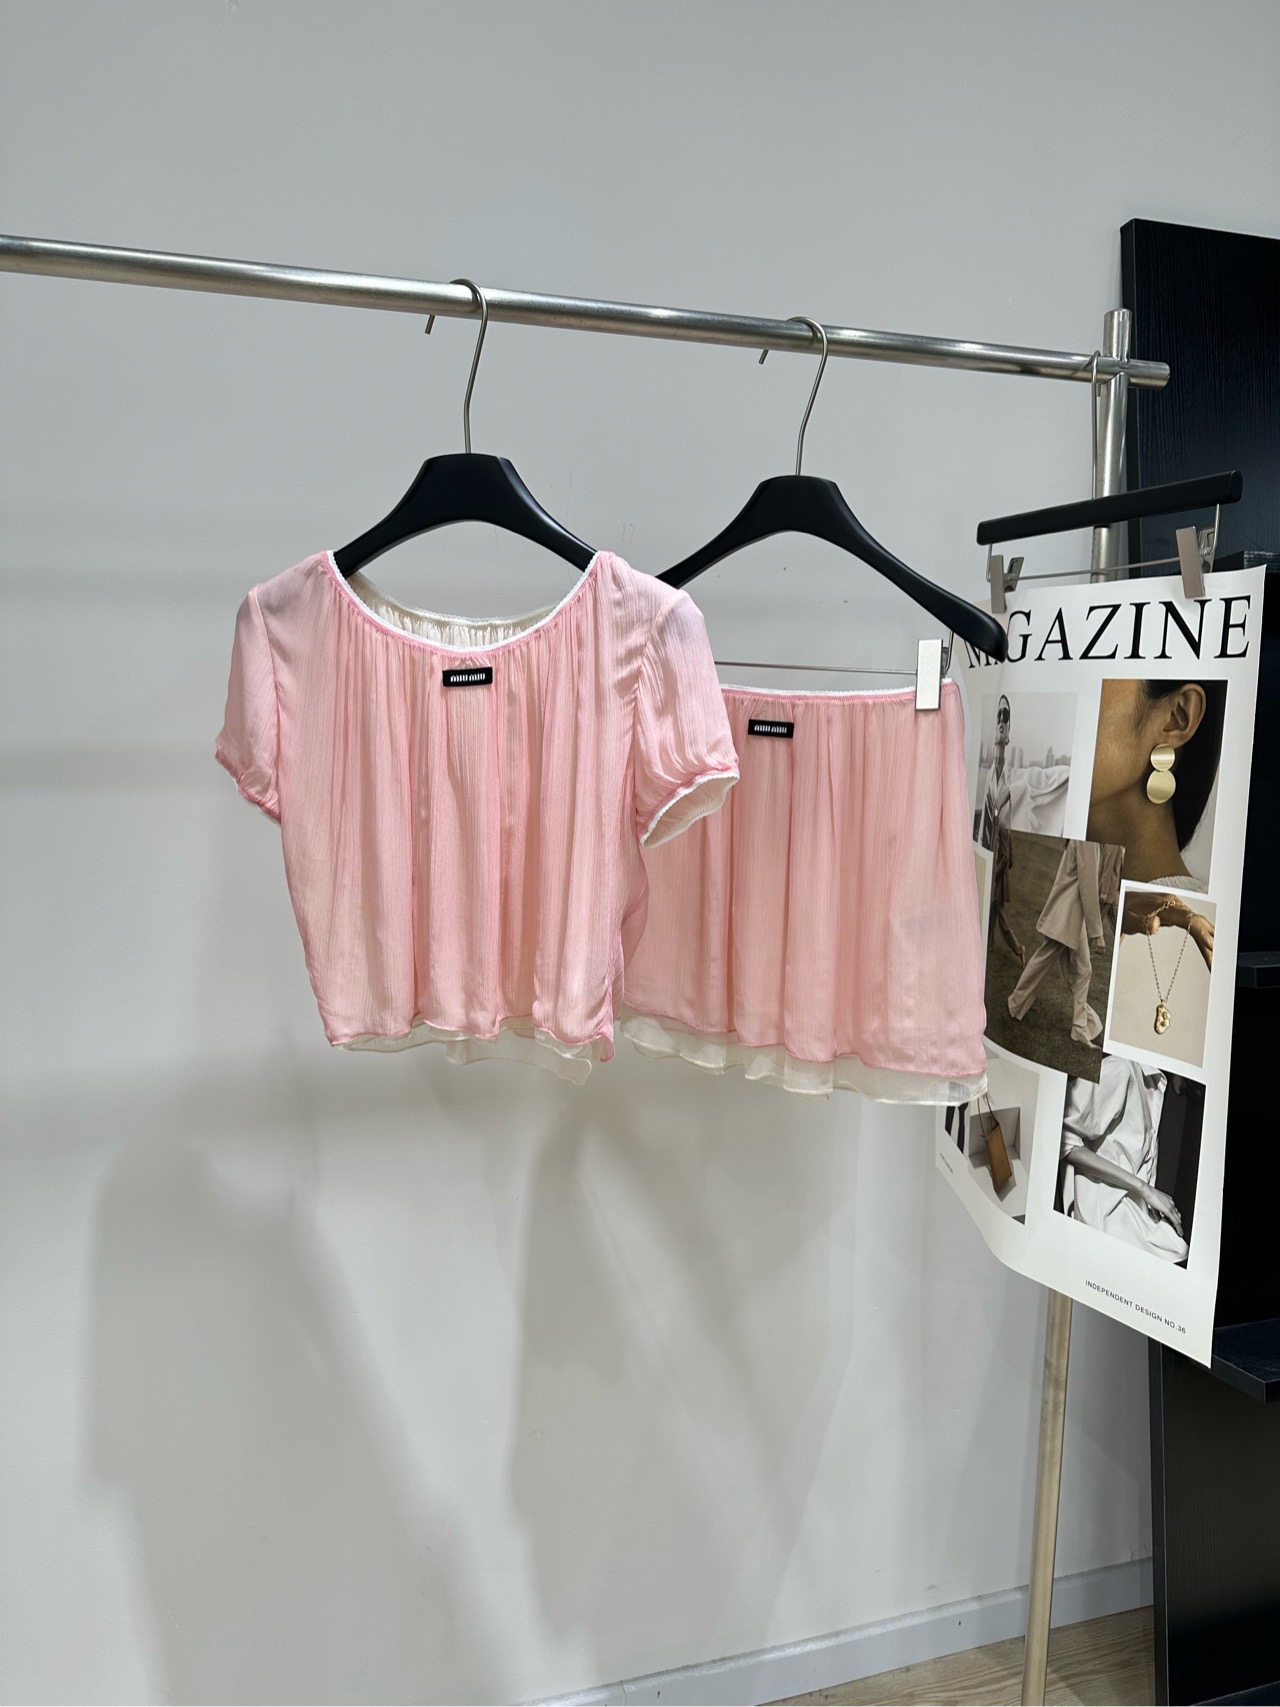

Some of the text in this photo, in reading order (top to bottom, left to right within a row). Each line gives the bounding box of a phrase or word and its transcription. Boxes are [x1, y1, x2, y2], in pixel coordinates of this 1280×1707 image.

[963, 595, 1251, 669] GAZINE
[1085, 1279, 1186, 1334] INDEPENDENT DESIGN NO.36
